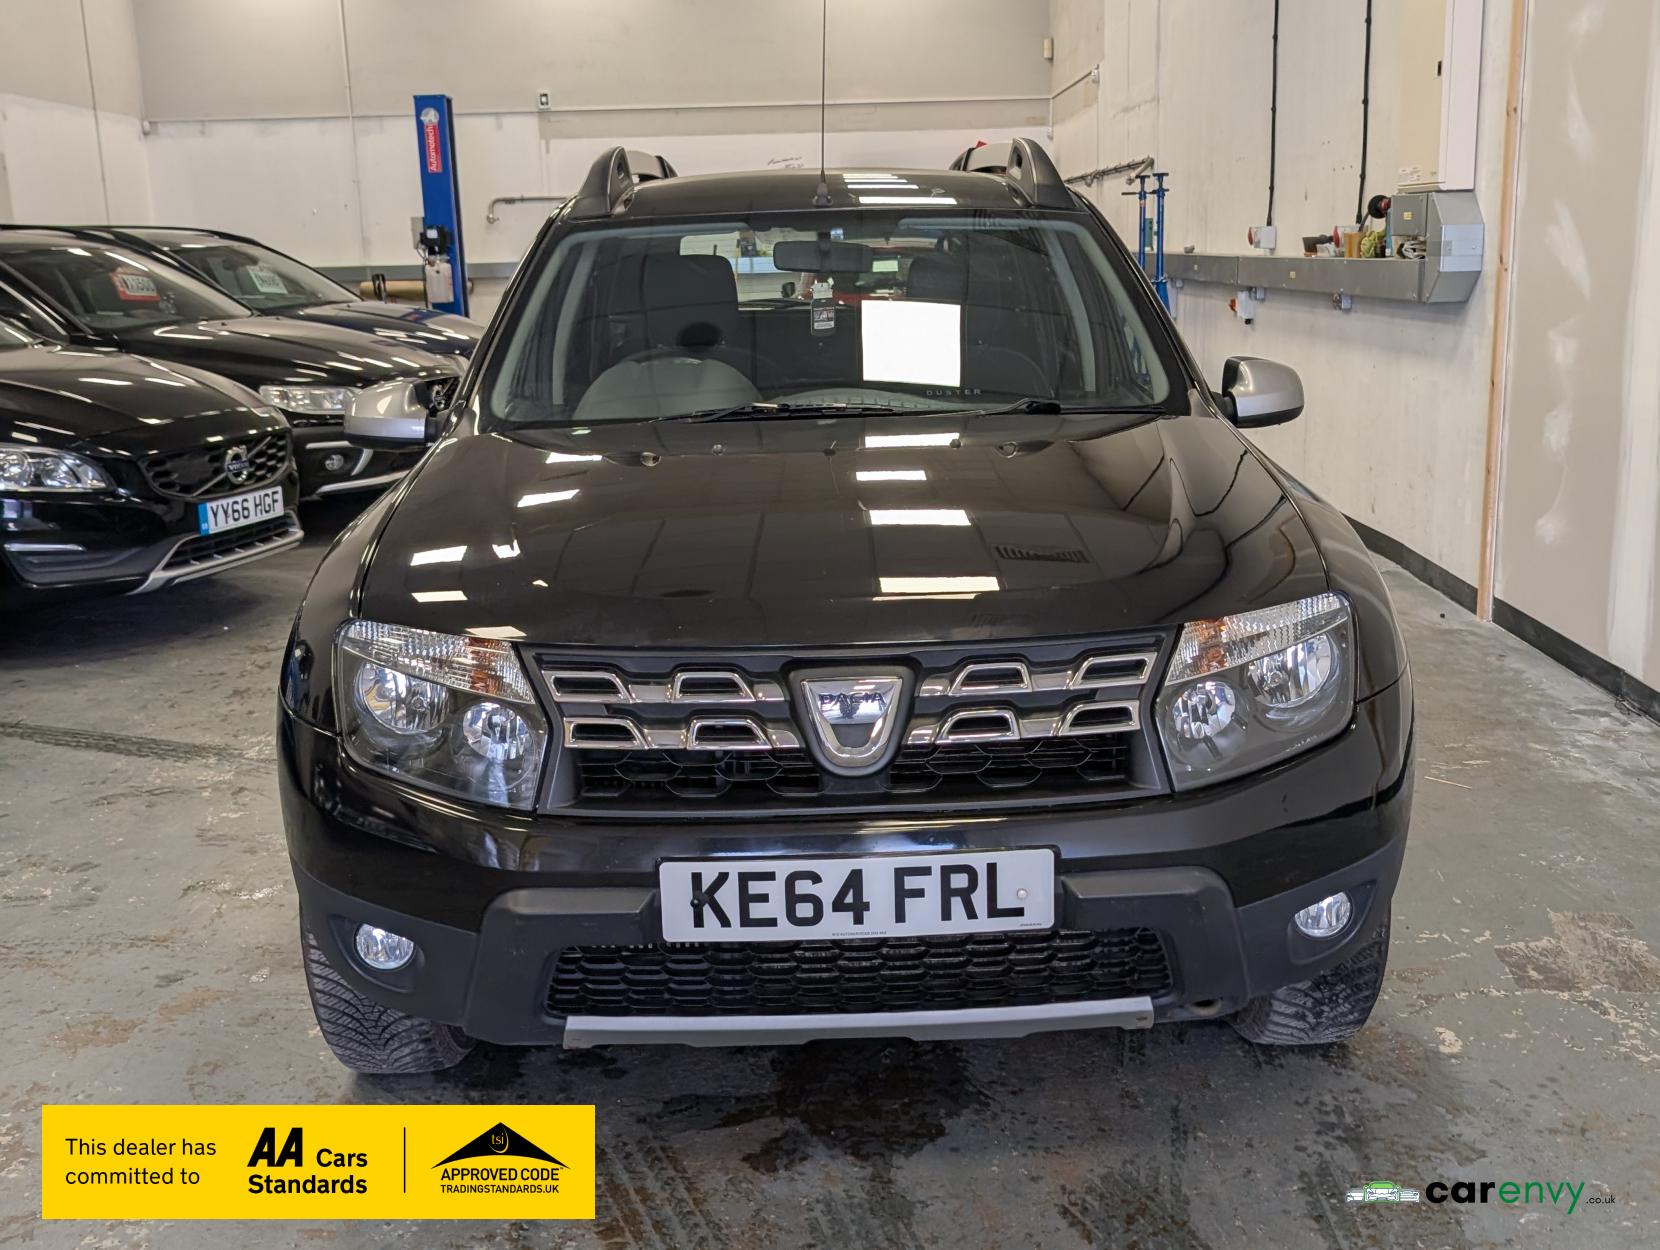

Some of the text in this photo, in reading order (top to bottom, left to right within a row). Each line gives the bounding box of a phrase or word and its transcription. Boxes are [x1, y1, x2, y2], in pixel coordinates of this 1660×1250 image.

[926, 388, 982, 396] DUSTER
[210, 490, 279, 527] YY66 HGF
[818, 692, 886, 706] DACIA
[690, 862, 1025, 929] KE64 FRL
